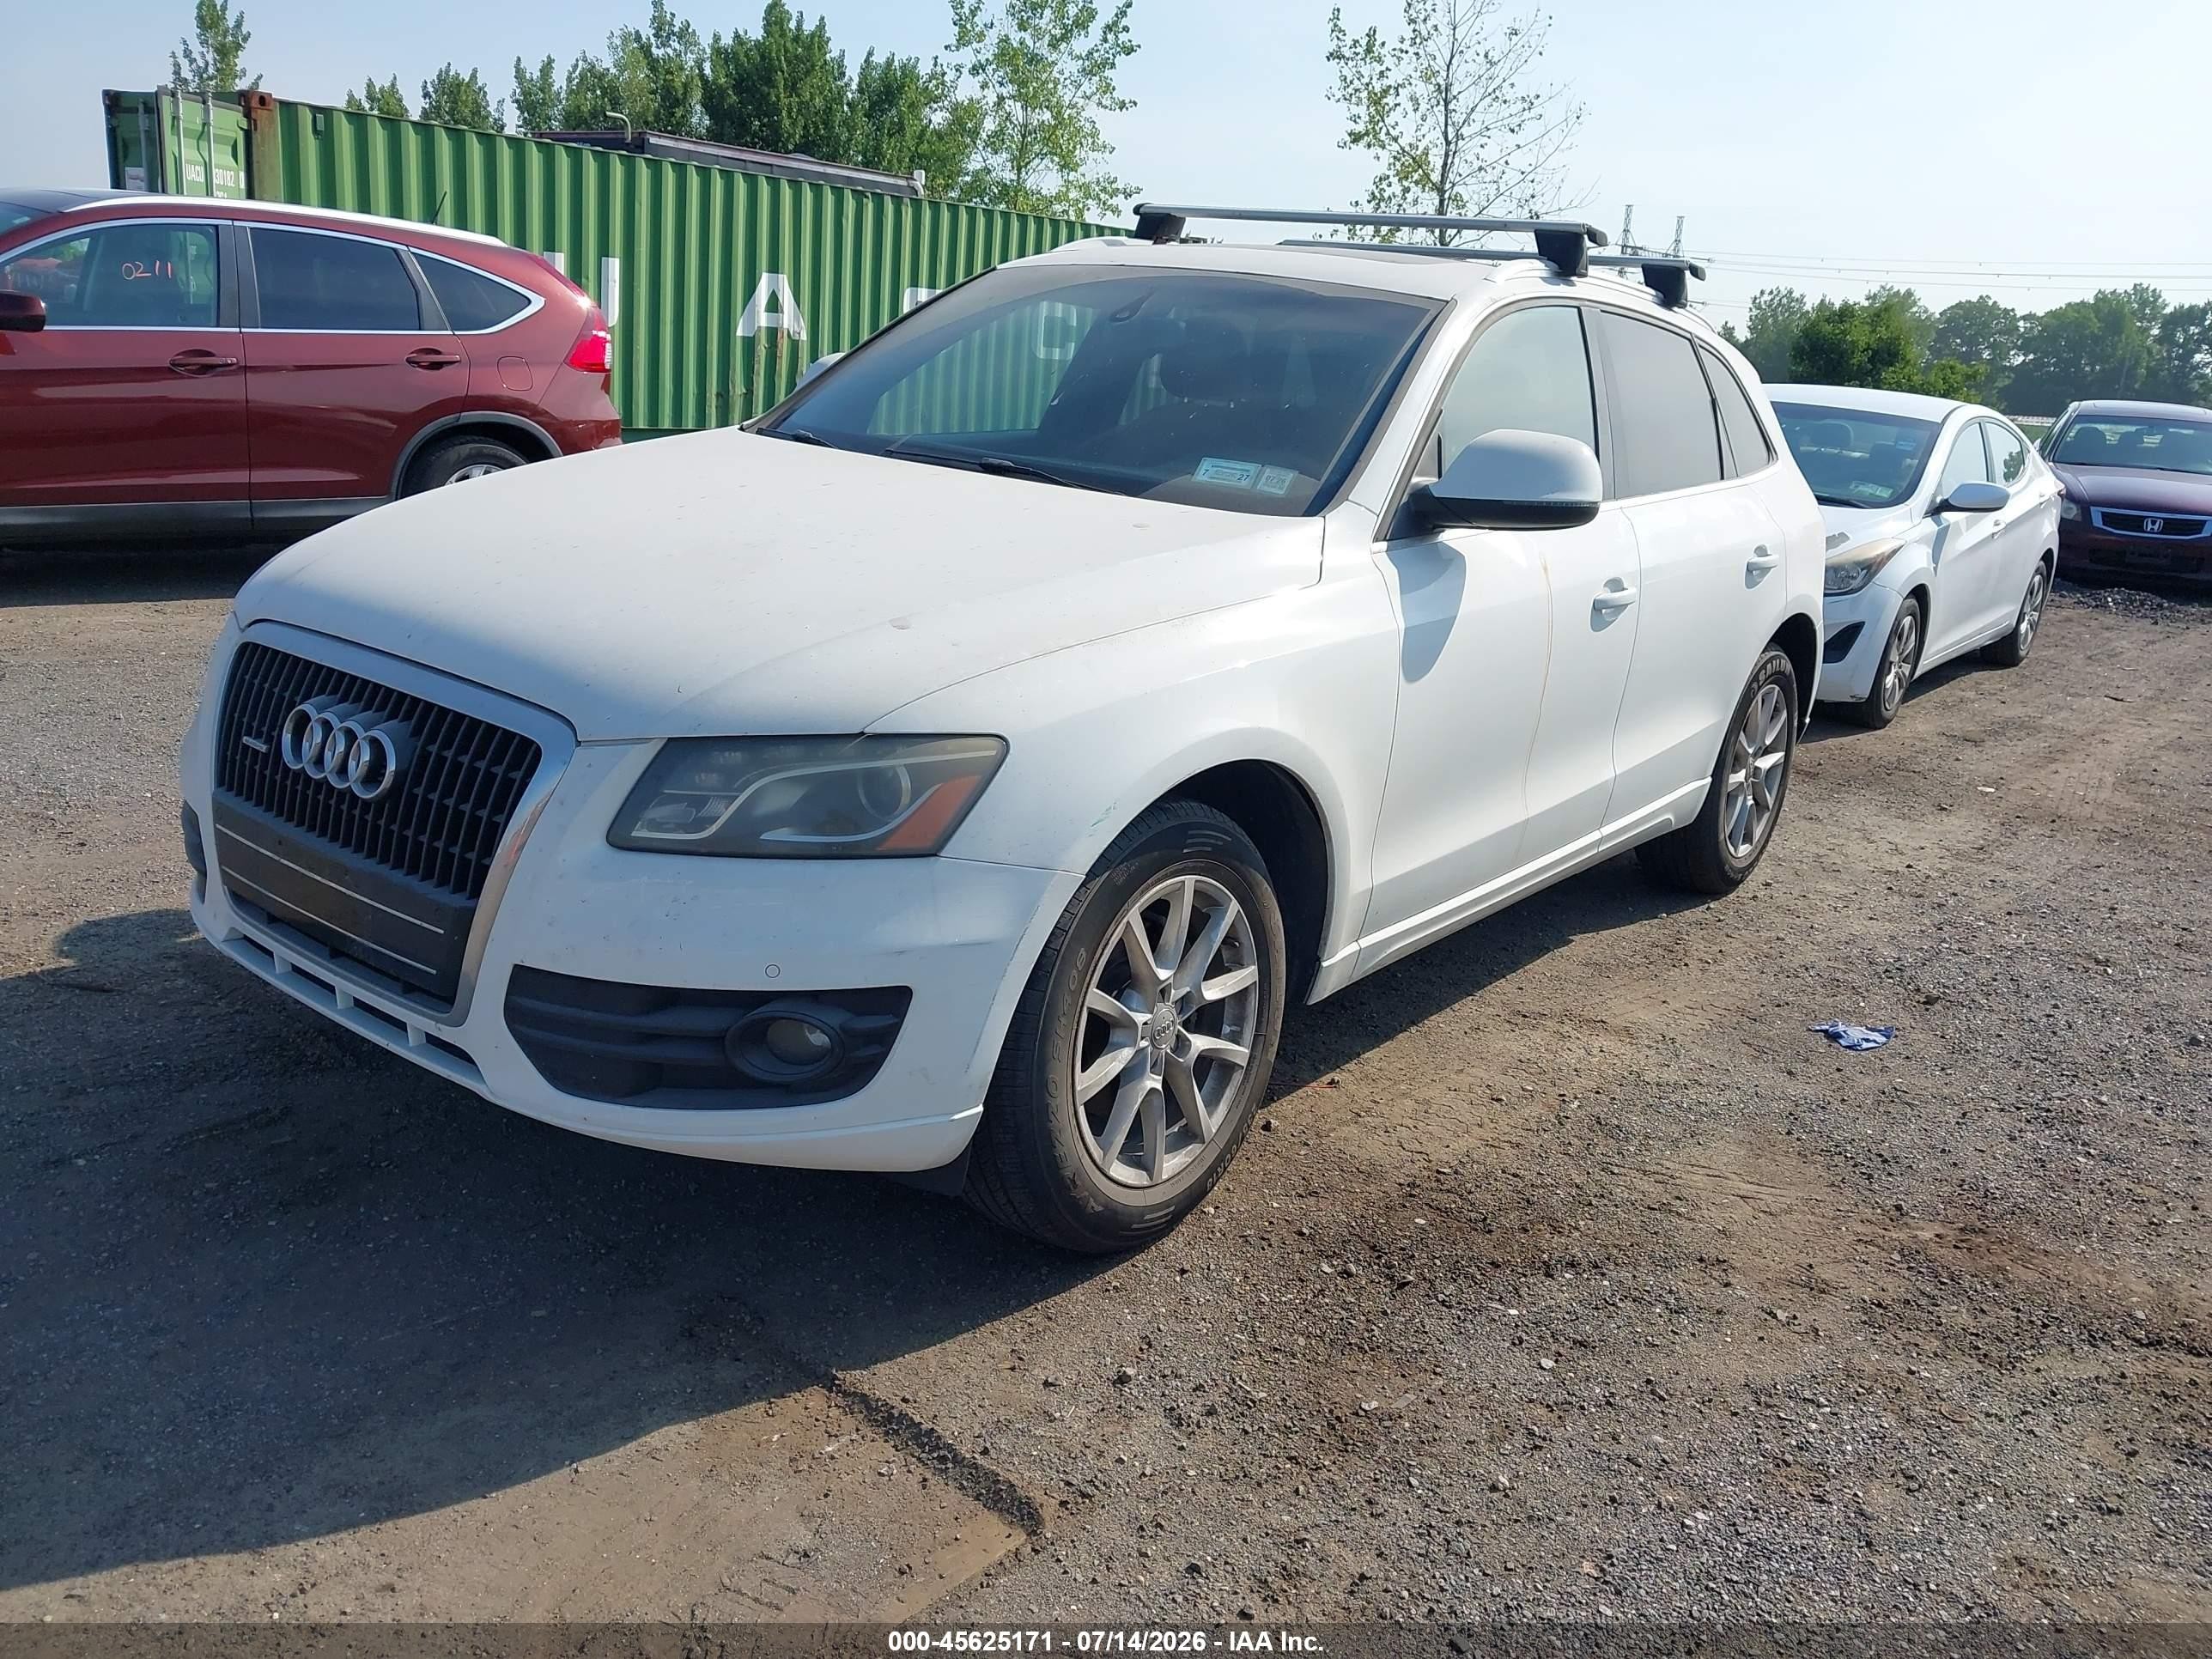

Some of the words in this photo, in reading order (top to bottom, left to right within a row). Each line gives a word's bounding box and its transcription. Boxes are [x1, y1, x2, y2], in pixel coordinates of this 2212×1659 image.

[185, 163, 204, 182] UACU
[214, 167, 235, 187] 30182
[122, 259, 171, 280] 0211
